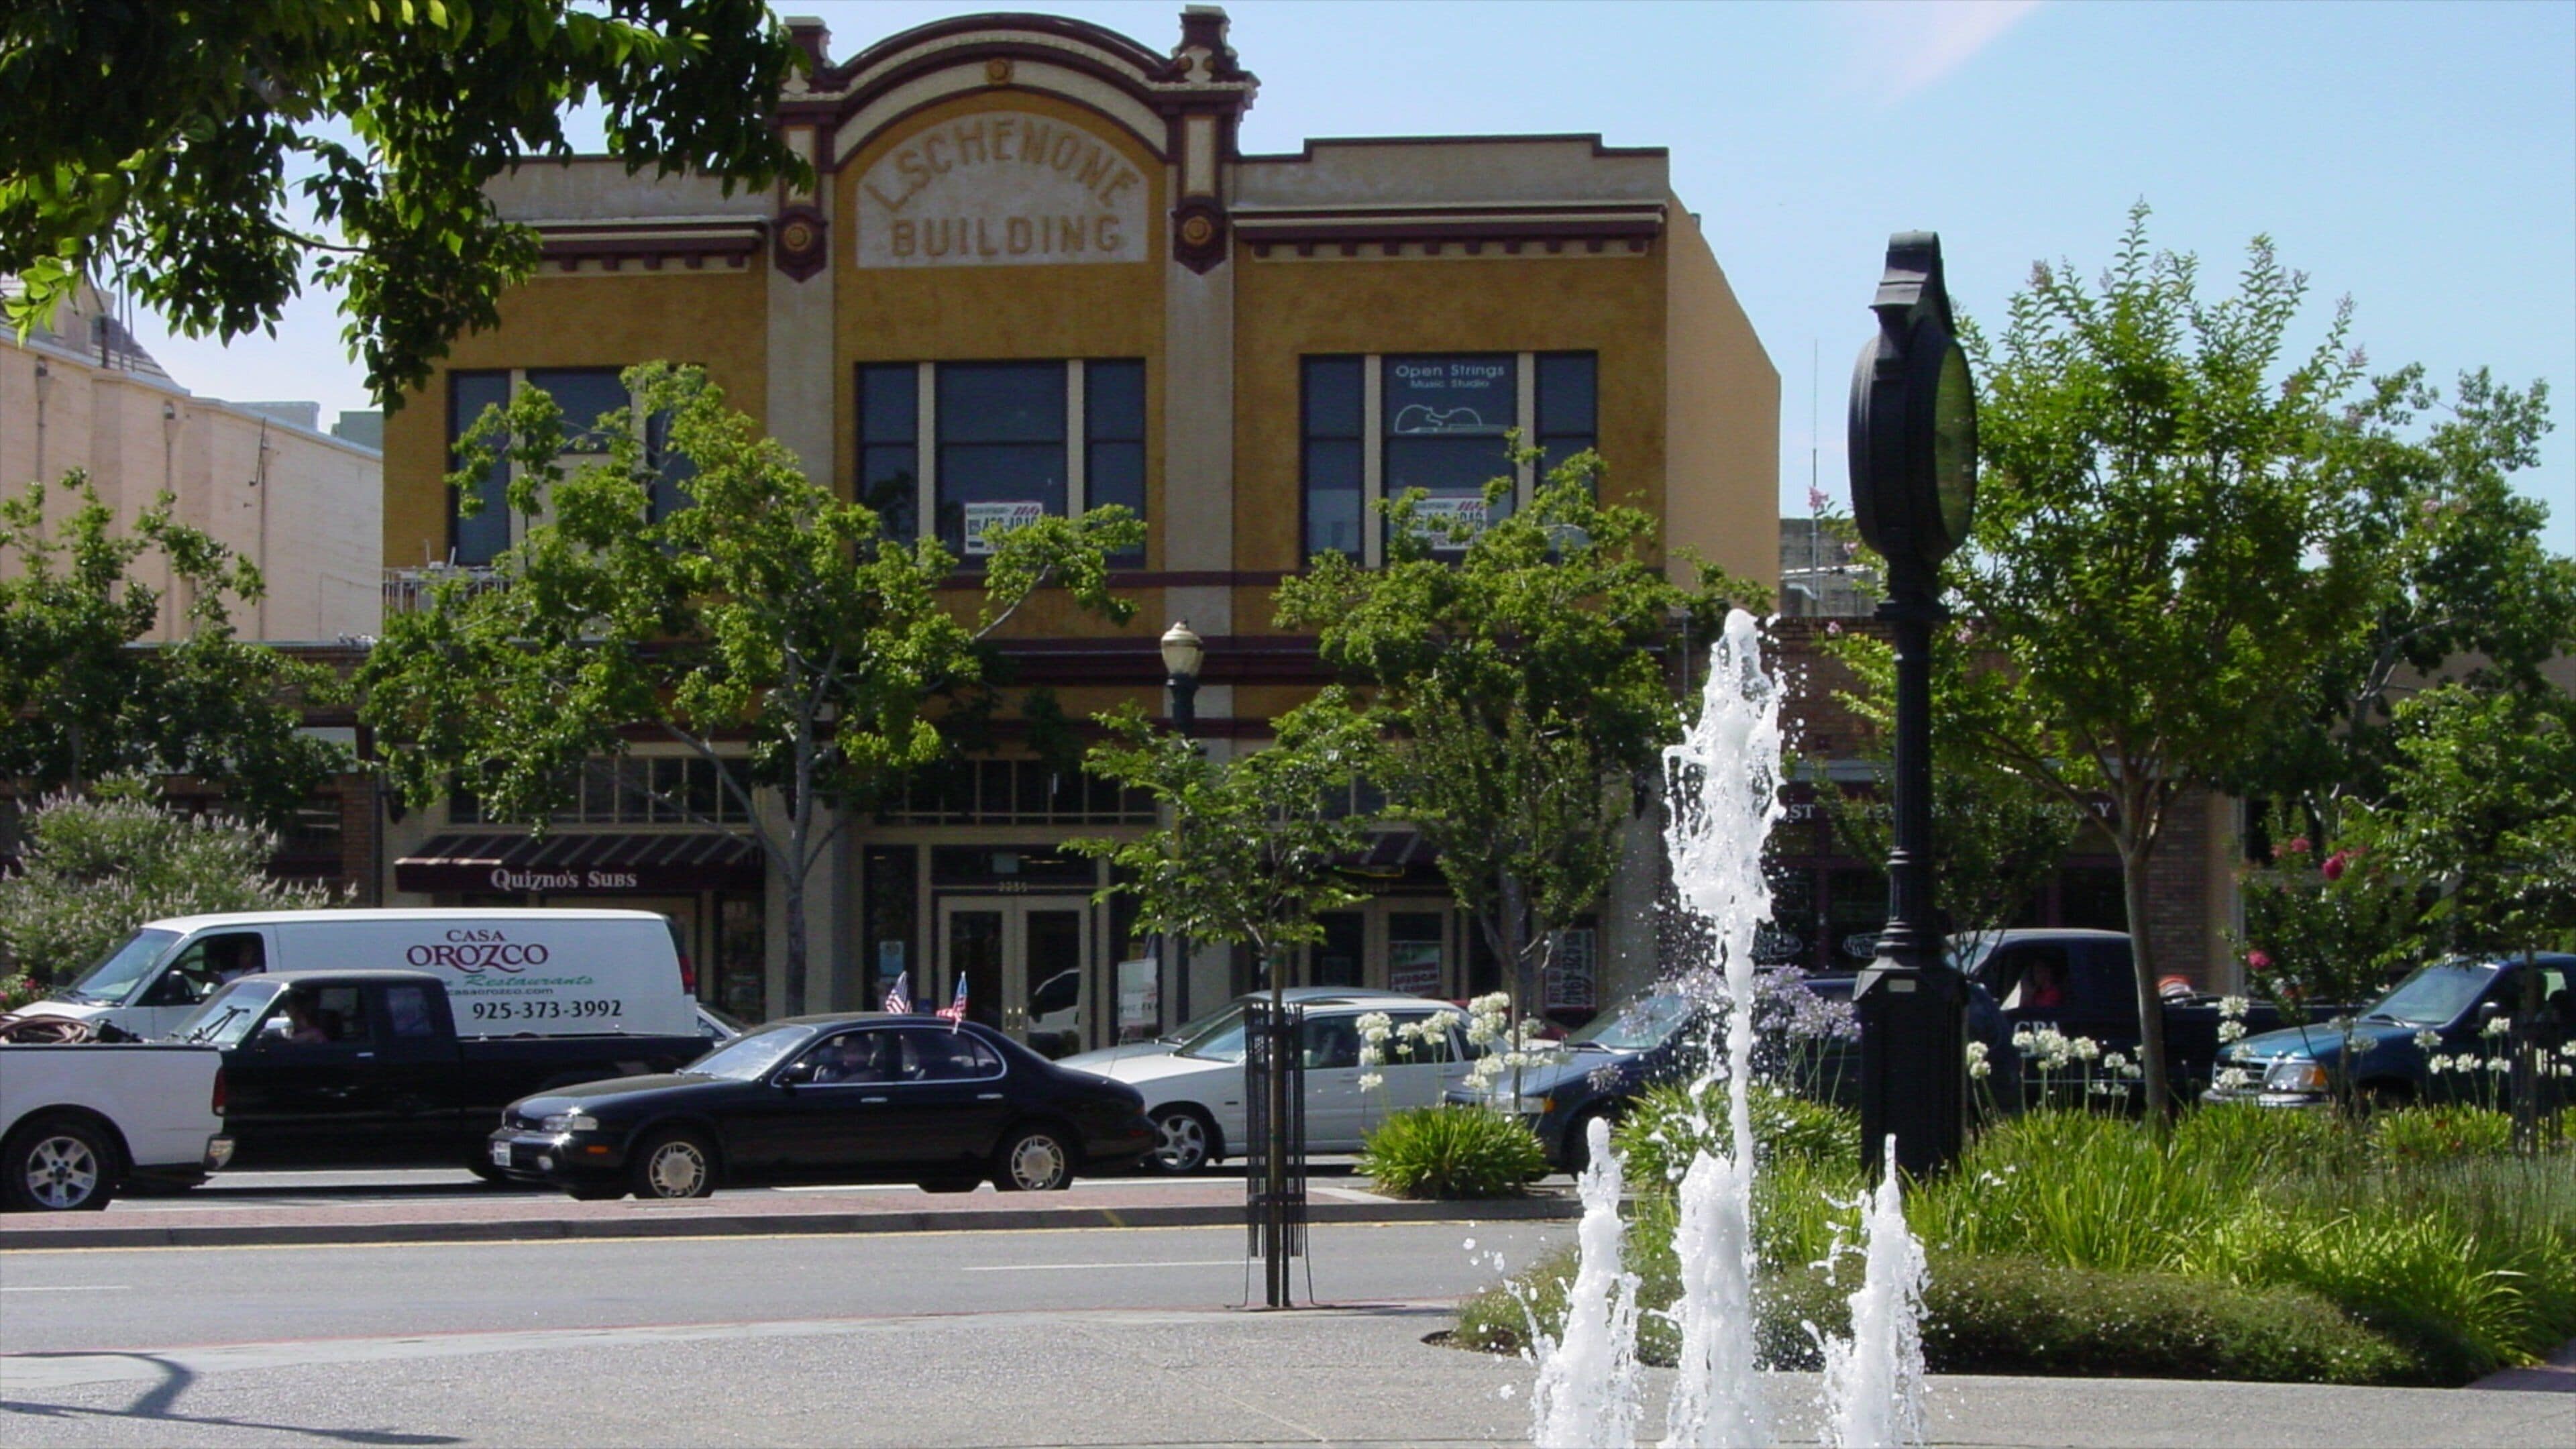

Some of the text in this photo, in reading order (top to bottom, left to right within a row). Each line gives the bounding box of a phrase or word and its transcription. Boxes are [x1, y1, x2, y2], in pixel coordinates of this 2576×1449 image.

[890, 214, 1120, 258] BUILDING
[1395, 364, 1505, 379] Open Strings
[1410, 378, 1490, 388] Music Studio
[490, 869, 580, 891] Quizno's
[445, 929, 506, 942] CASA
[407, 944, 549, 973] OROZCO
[464, 974, 594, 987] Restaurants
[472, 1000, 623, 1020] 925-373-3992
